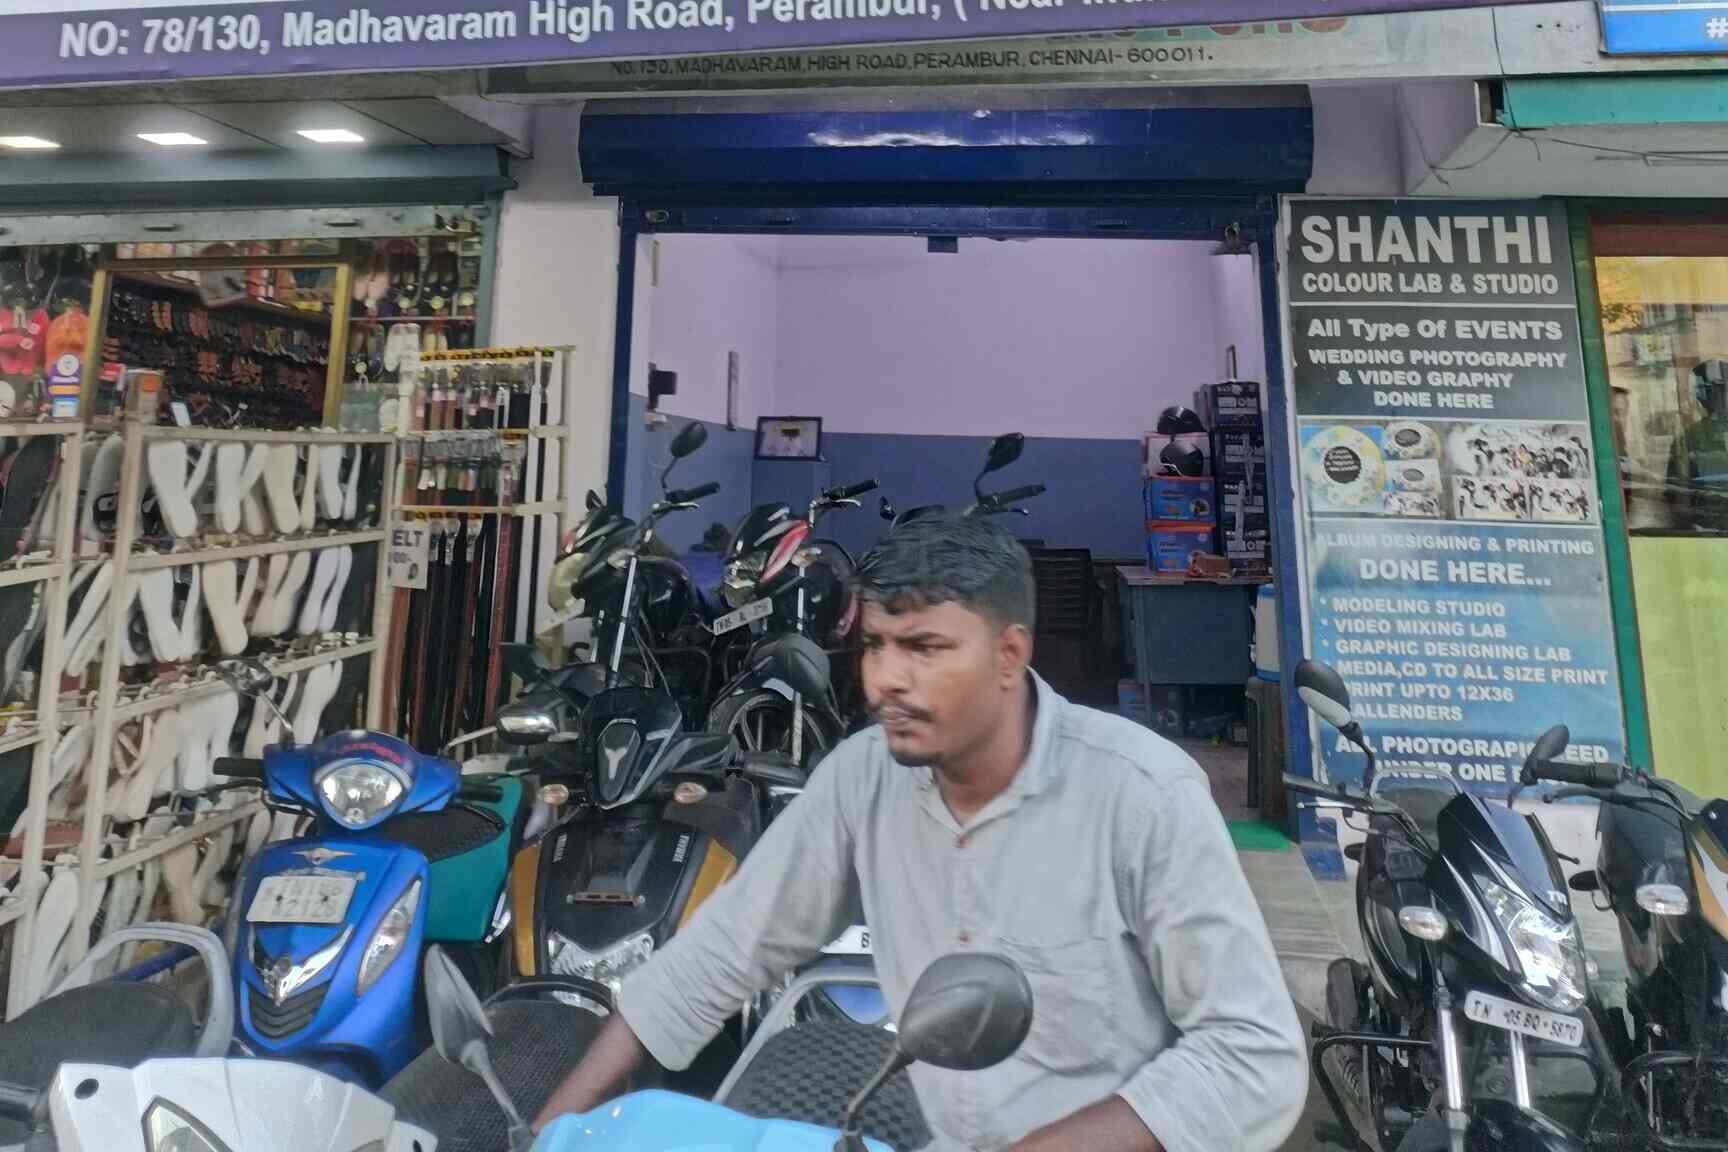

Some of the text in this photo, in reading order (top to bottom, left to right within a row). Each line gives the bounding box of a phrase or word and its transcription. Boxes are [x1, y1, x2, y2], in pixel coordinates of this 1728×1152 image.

[60, 21, 129, 58] NO:
[142, 14, 270, 55] 78/130,
[281, 7, 516, 49] Madhavaram
[1301, 215, 1552, 264] SHANTHI
[1302, 272, 1558, 295] COLOUR LAB & STUDIO
[1308, 319, 1563, 341] All Type Of EVENTS
[1308, 349, 1568, 368] WEDDING PHOTOGRAPHY
[1337, 370, 1514, 389] & VIDEO GRAPHY
[1374, 391, 1494, 409] DONE HERE
[1315, 532, 1595, 555] ALBUM DESIGNING & PRINTING
[1359, 557, 1551, 587] DONE HERE...
[1333, 598, 1506, 617] MODELING STUDIO
[1335, 618, 1507, 637] VIDEO MIXING LAB
[1336, 639, 1572, 662] GRAPHIC DESIGNING LAB
[1432, 664, 1458, 678] TO
[1463, 665, 1499, 681] ALL
[1503, 668, 1546, 683] SIZE
[1552, 669, 1609, 685] PRINT
[1401, 683, 1451, 699] UPTO
[1458, 685, 1514, 703] 12X36
[1350, 703, 1463, 721] ALLENDERS
[1559, 744, 1609, 763] EED
[1459, 761, 1506, 783] ONE
